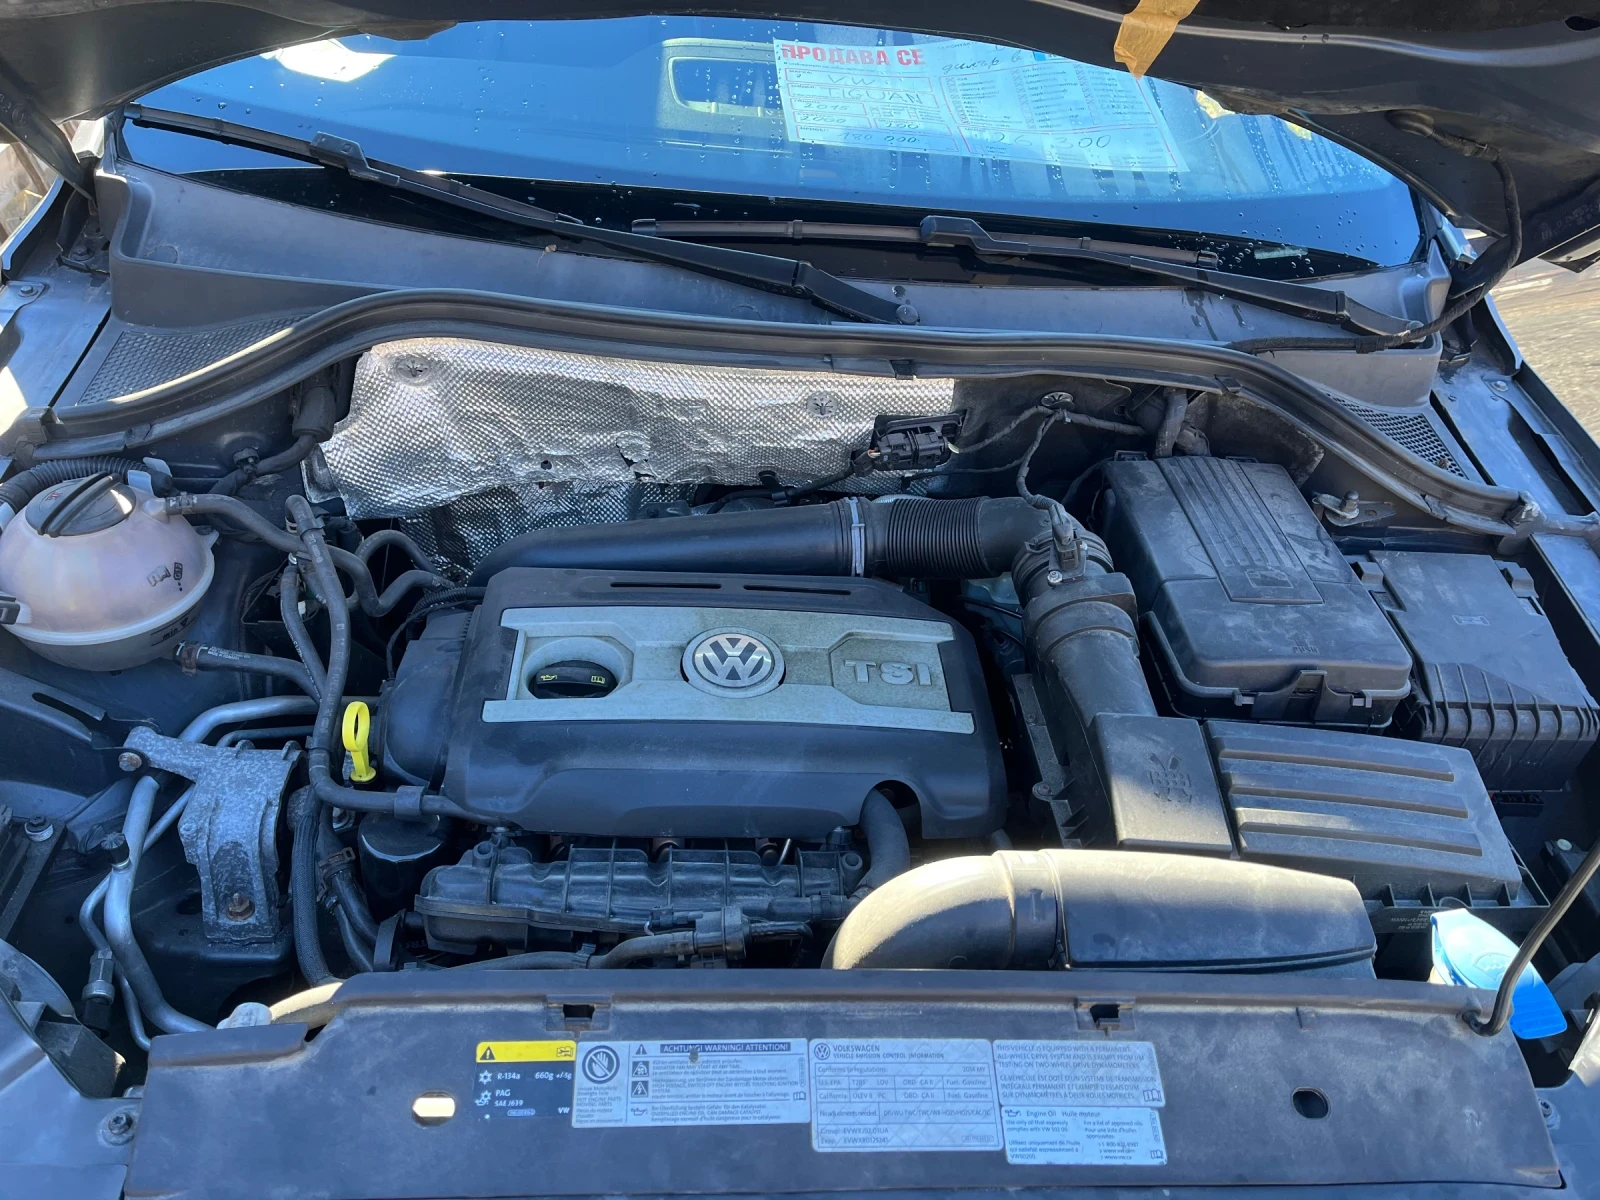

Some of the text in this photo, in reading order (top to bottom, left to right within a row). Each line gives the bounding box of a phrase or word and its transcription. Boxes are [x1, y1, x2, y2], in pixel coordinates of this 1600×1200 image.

[781, 43, 891, 66] ПРОДАВА
[896, 48, 928, 66] СЕ
[844, 659, 932, 686] TSI
[663, 1042, 788, 1053] ACHTUNG! WARNING! ATTENTION!
[497, 1072, 520, 1080] R-134a
[535, 1071, 554, 1080] 660g
[495, 1089, 511, 1097] PAG
